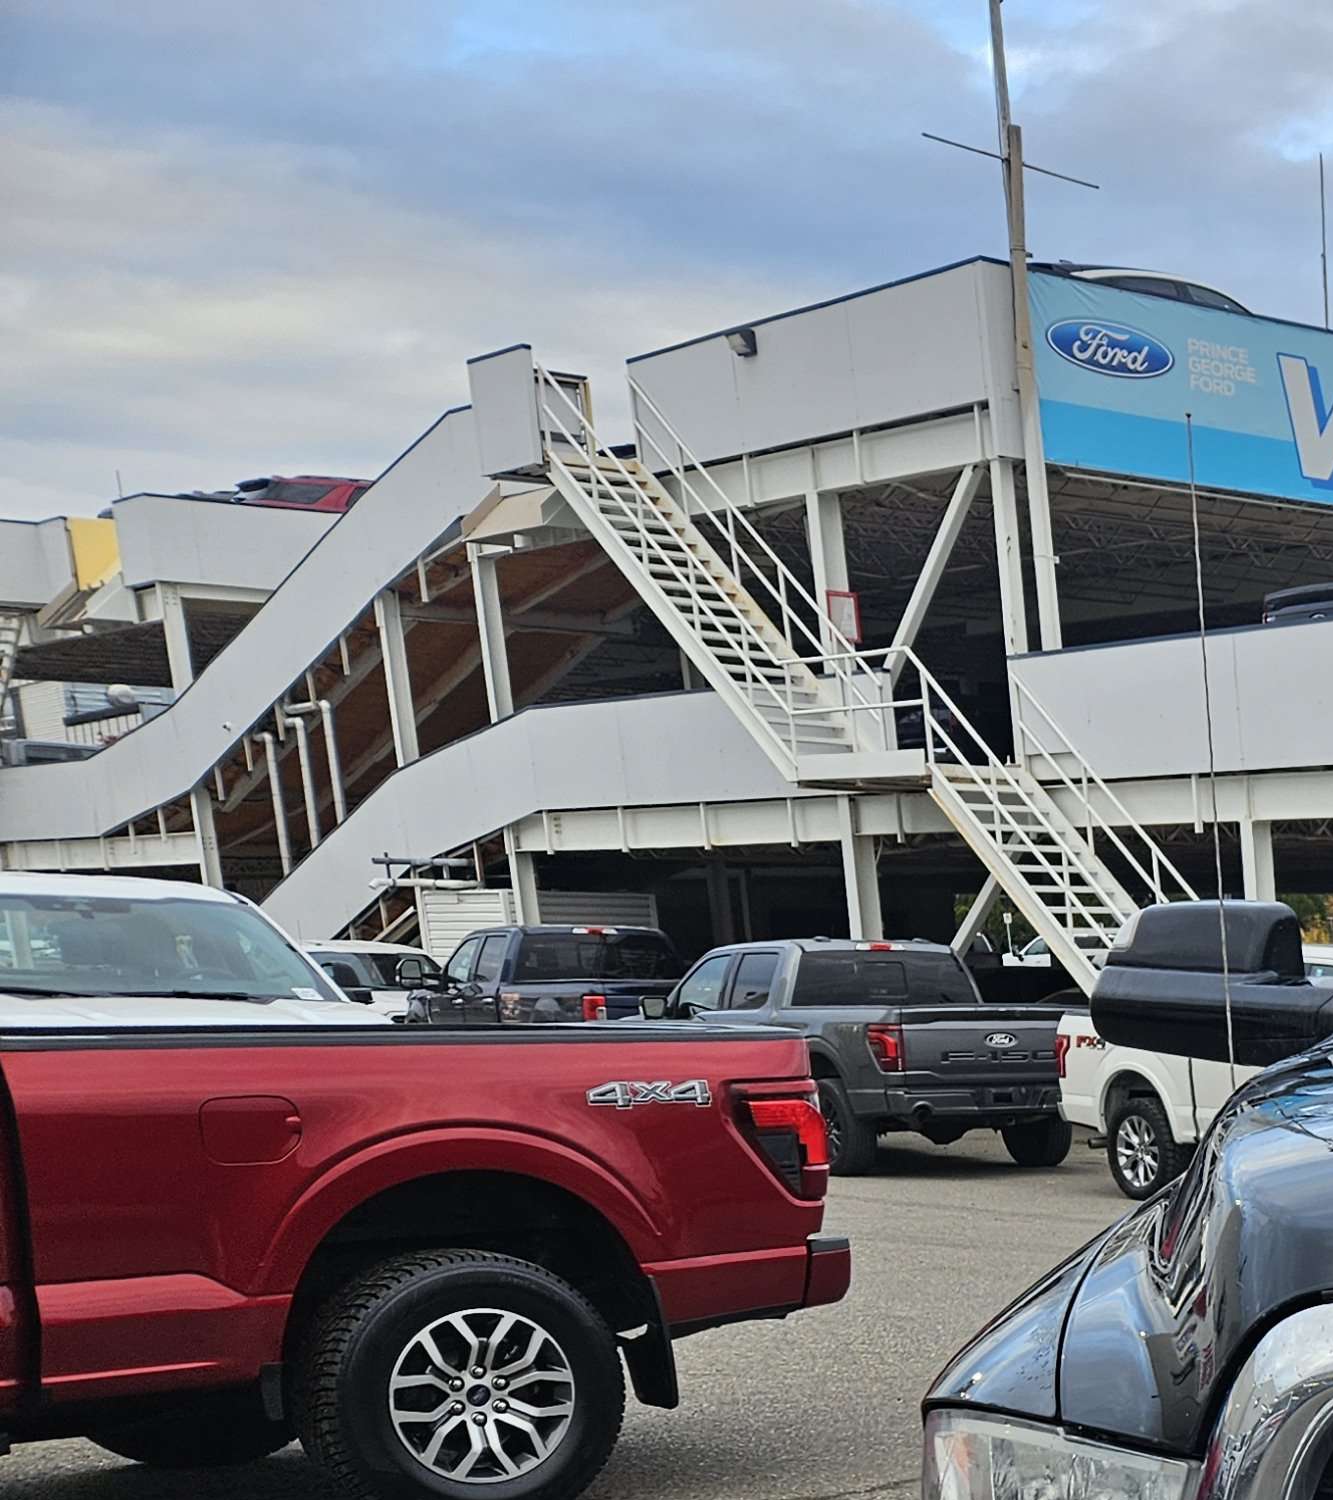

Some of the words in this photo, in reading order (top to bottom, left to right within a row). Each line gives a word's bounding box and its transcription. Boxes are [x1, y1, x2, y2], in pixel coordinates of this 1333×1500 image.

[1072, 324, 1149, 372] Ford
[1187, 338, 1248, 365] PRINCE
[1188, 356, 1256, 384] GEORGE
[1190, 374, 1235, 396] FORD
